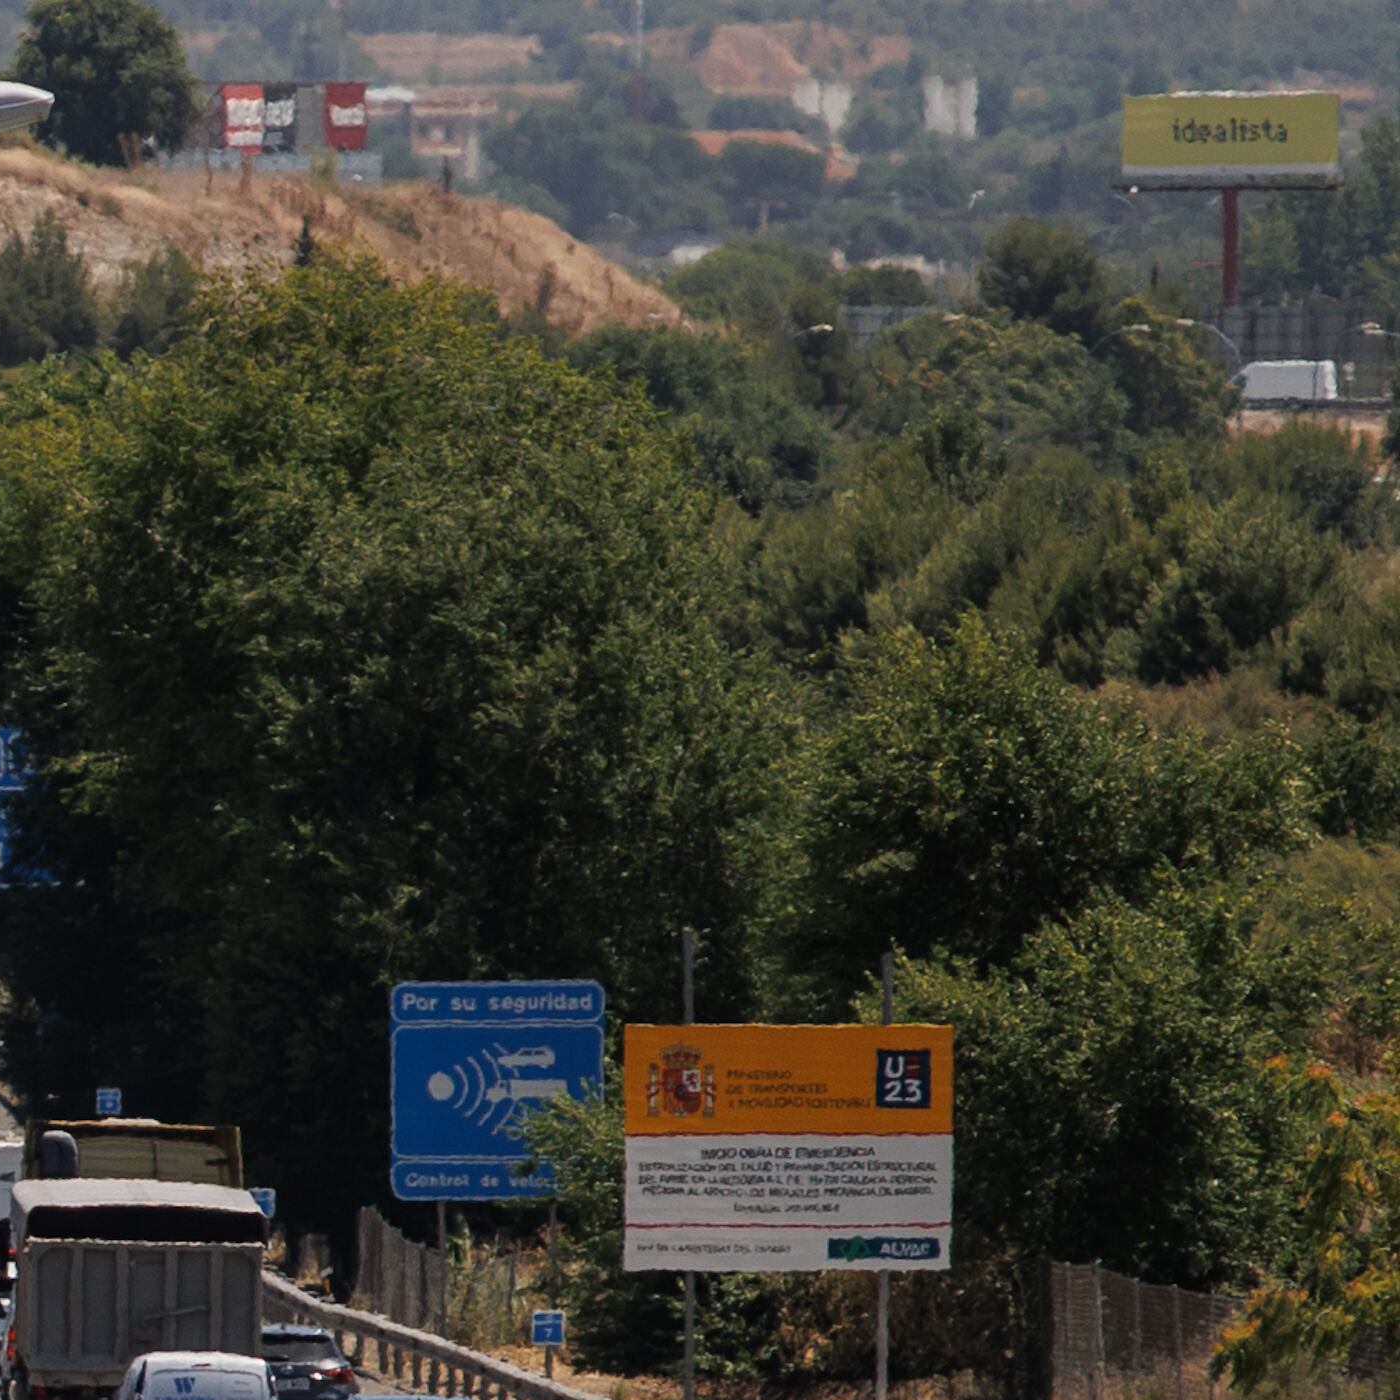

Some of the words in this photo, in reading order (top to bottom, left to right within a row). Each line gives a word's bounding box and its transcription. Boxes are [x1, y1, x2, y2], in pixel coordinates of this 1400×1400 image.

[1172, 117, 1288, 143] idealista
[402, 993, 439, 1011] Por
[451, 998, 476, 1011] su
[488, 993, 593, 1013] seguridad
[884, 1079, 922, 1102] 23
[405, 1173, 470, 1187] Control
[480, 1174, 499, 1187] de
